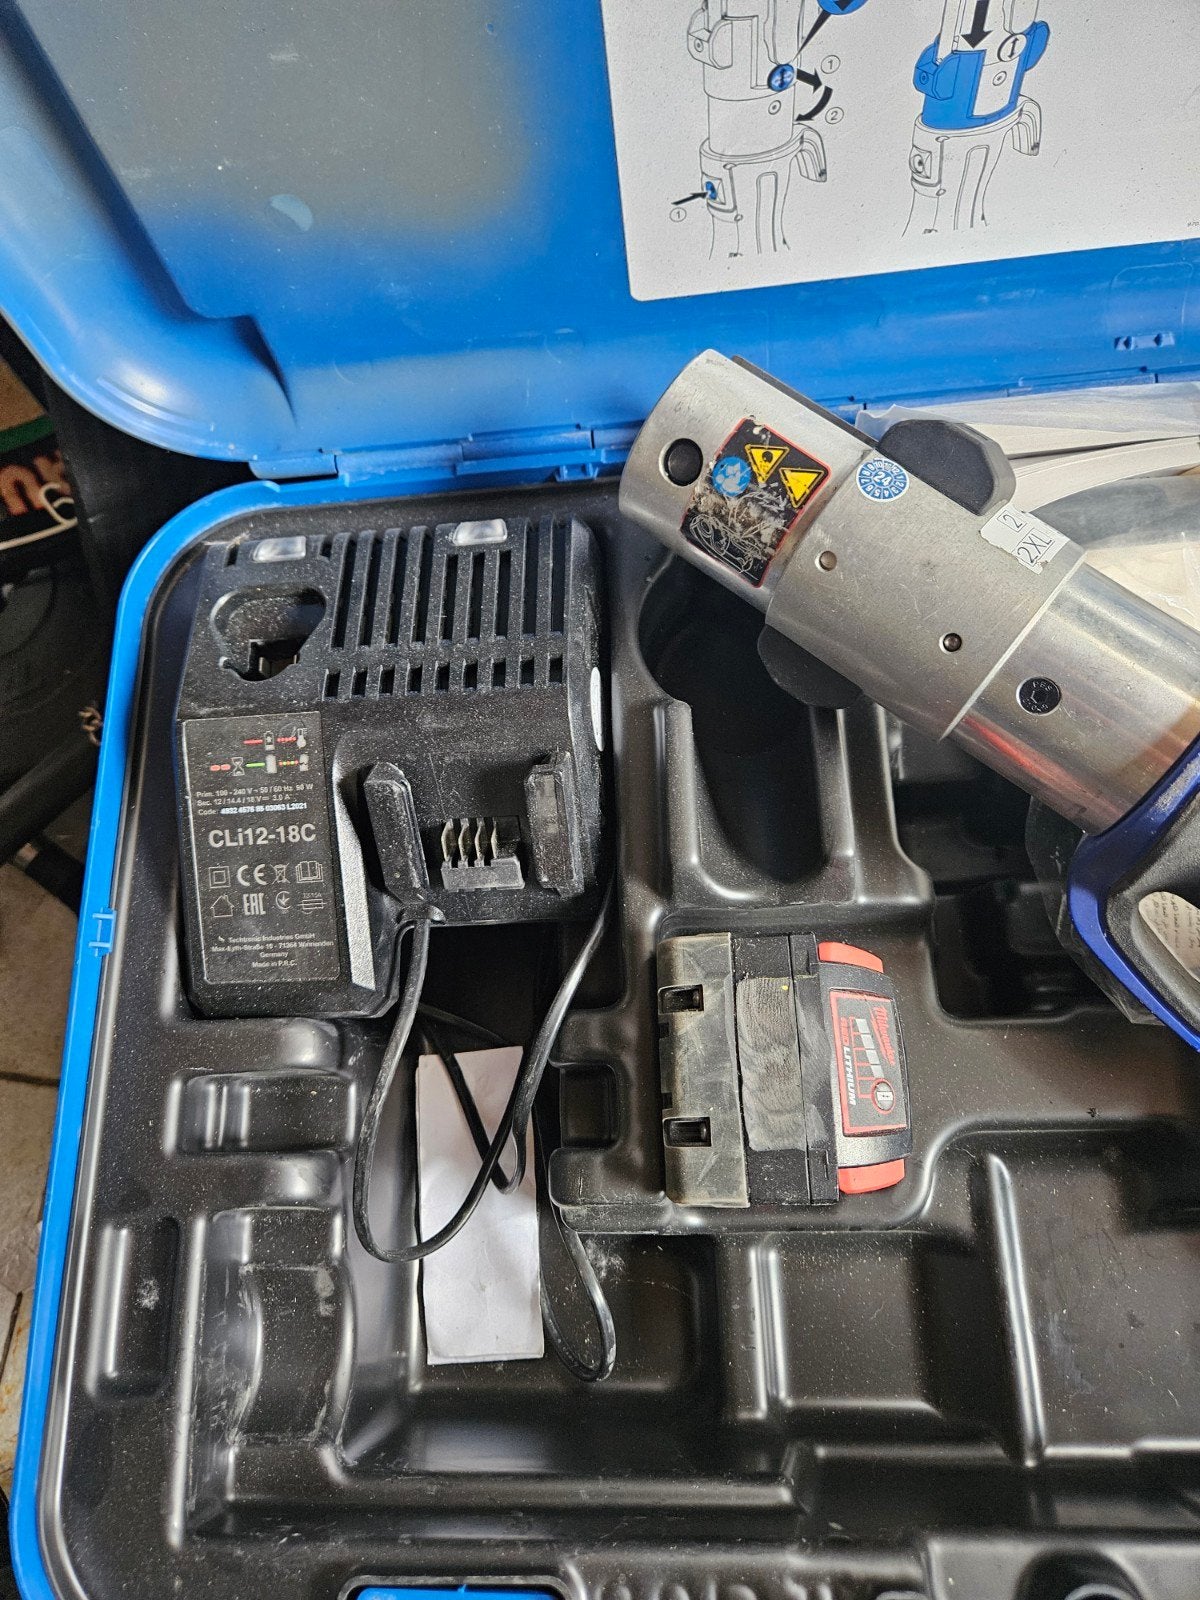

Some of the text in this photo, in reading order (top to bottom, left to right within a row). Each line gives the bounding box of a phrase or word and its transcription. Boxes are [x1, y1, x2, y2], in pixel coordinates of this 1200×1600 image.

[873, 471, 892, 487] 24
[1002, 514, 1023, 529] 2
[1016, 533, 1053, 563] 2XL
[208, 823, 317, 848] CLi12-18C
